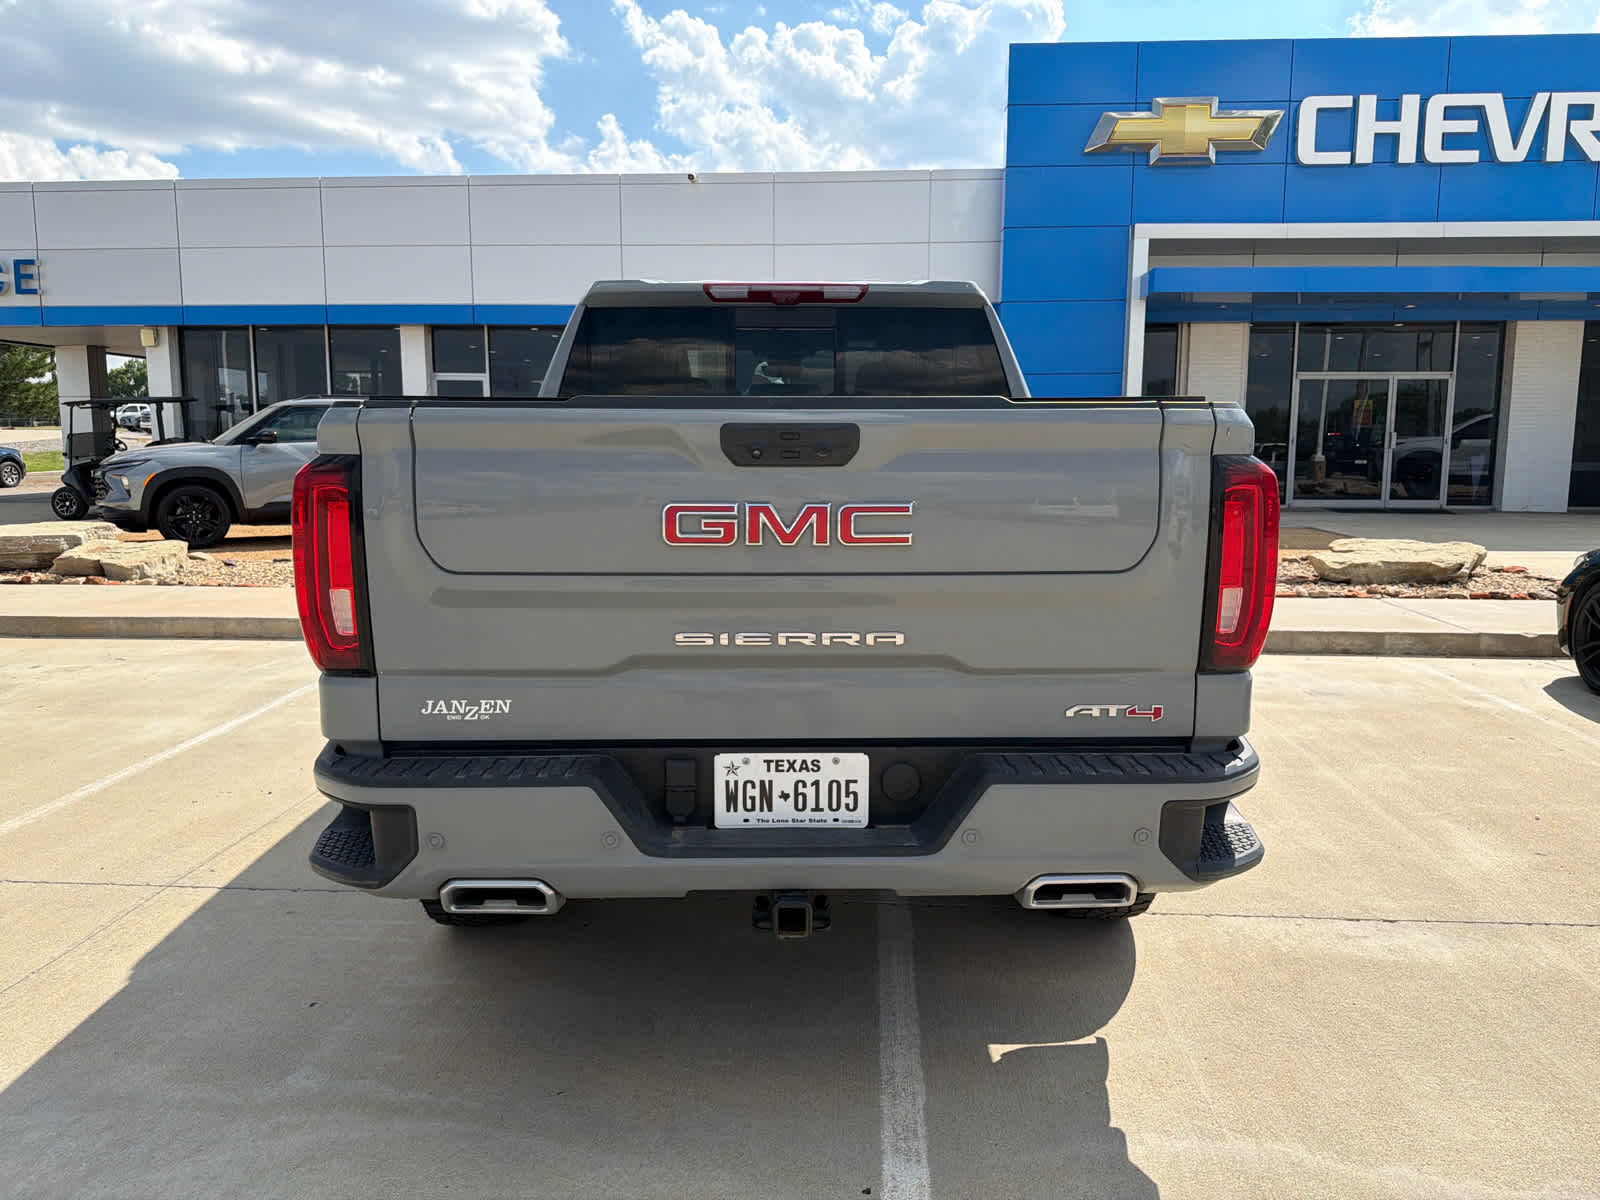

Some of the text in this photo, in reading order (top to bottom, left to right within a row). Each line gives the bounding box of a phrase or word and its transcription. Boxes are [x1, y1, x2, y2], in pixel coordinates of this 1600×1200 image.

[0, 258, 38, 296] E
[662, 502, 913, 546] GMC
[674, 632, 905, 646] SIERRA
[421, 699, 512, 720] JANZEN
[1065, 704, 1164, 721] AT4
[763, 759, 821, 773] TEXAS
[724, 779, 859, 813] WGN 6105
